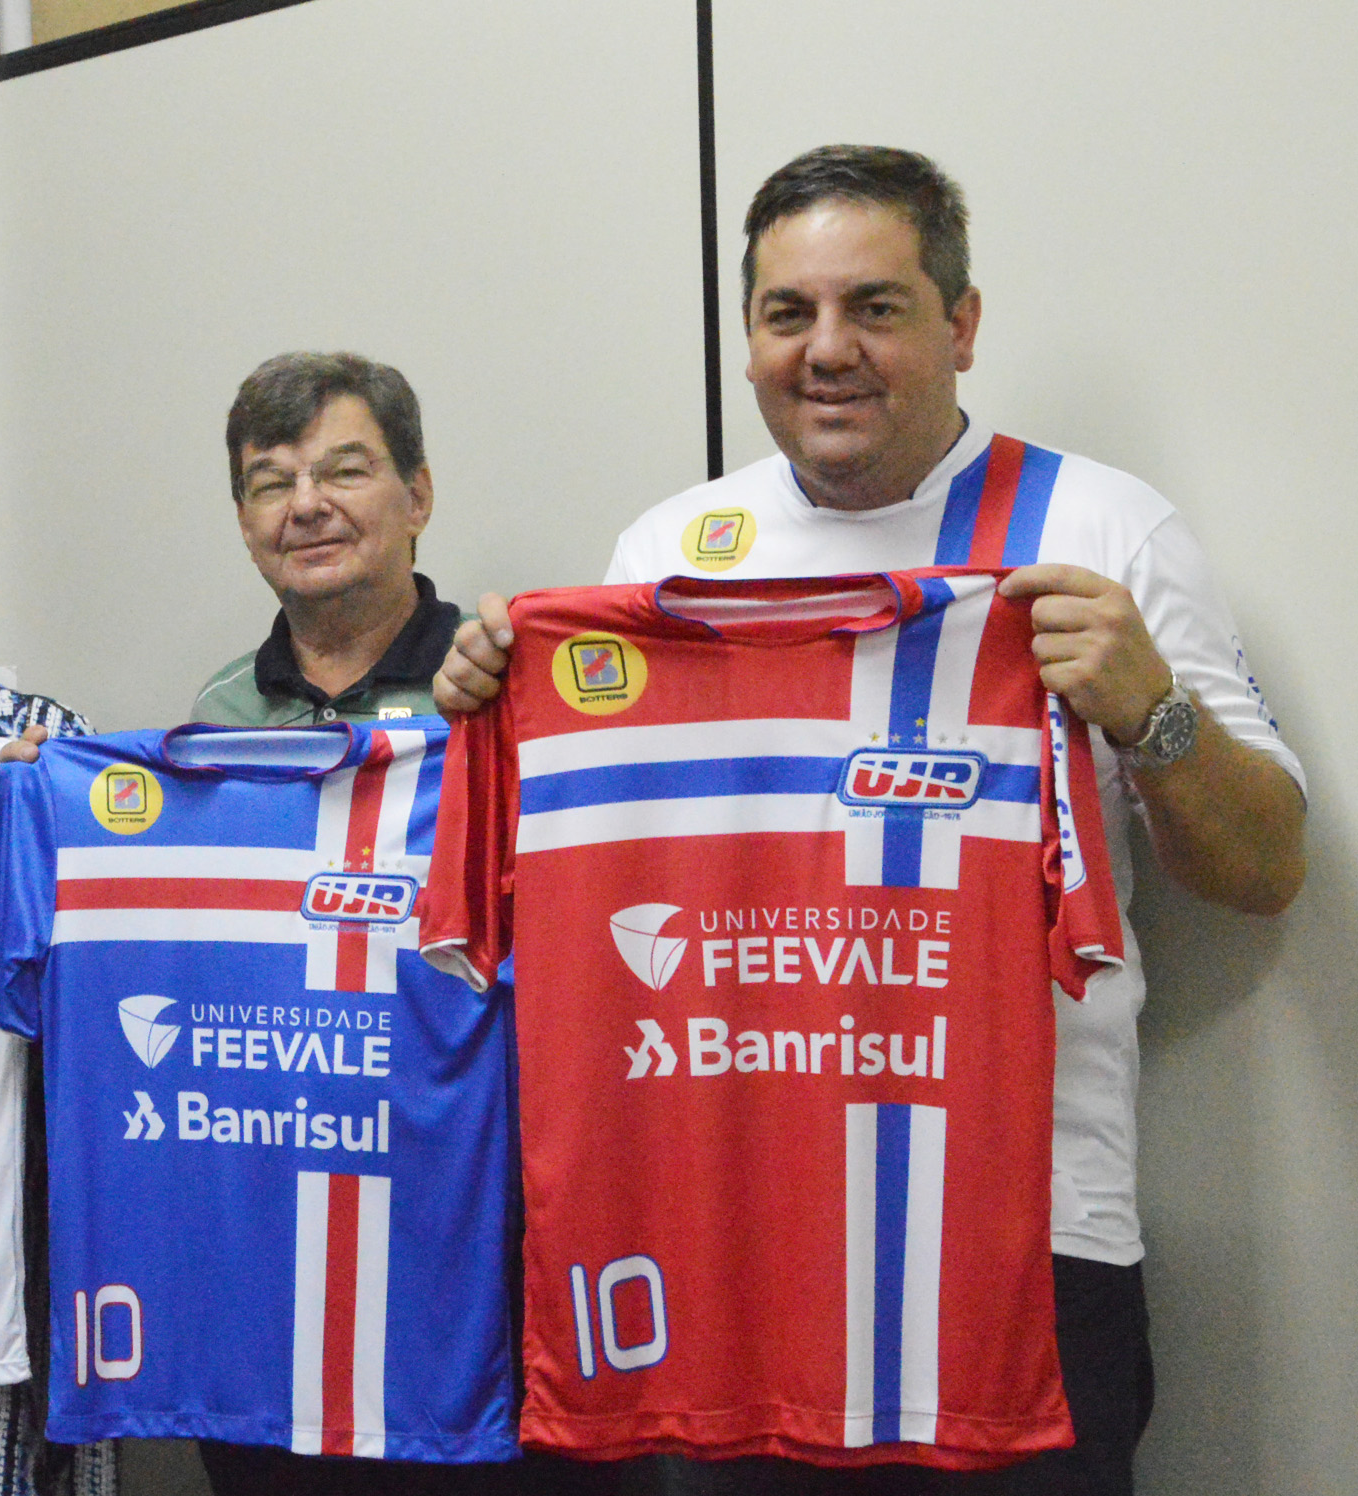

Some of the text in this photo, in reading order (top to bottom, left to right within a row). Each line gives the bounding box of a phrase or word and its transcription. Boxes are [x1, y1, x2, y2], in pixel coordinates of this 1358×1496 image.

[852, 760, 973, 799] UJR
[311, 881, 406, 916] UJR
[699, 905, 952, 934] UNIVERSIDADE
[701, 935, 950, 990] FEEVALE
[190, 1002, 392, 1032] UNIVERSIDADE
[191, 1027, 392, 1078] FEEVALE
[687, 1013, 947, 1081] Banrisul
[177, 1090, 390, 1154] Banrisul
[74, 1282, 142, 1388] 10
[568, 1253, 670, 1381] 10
